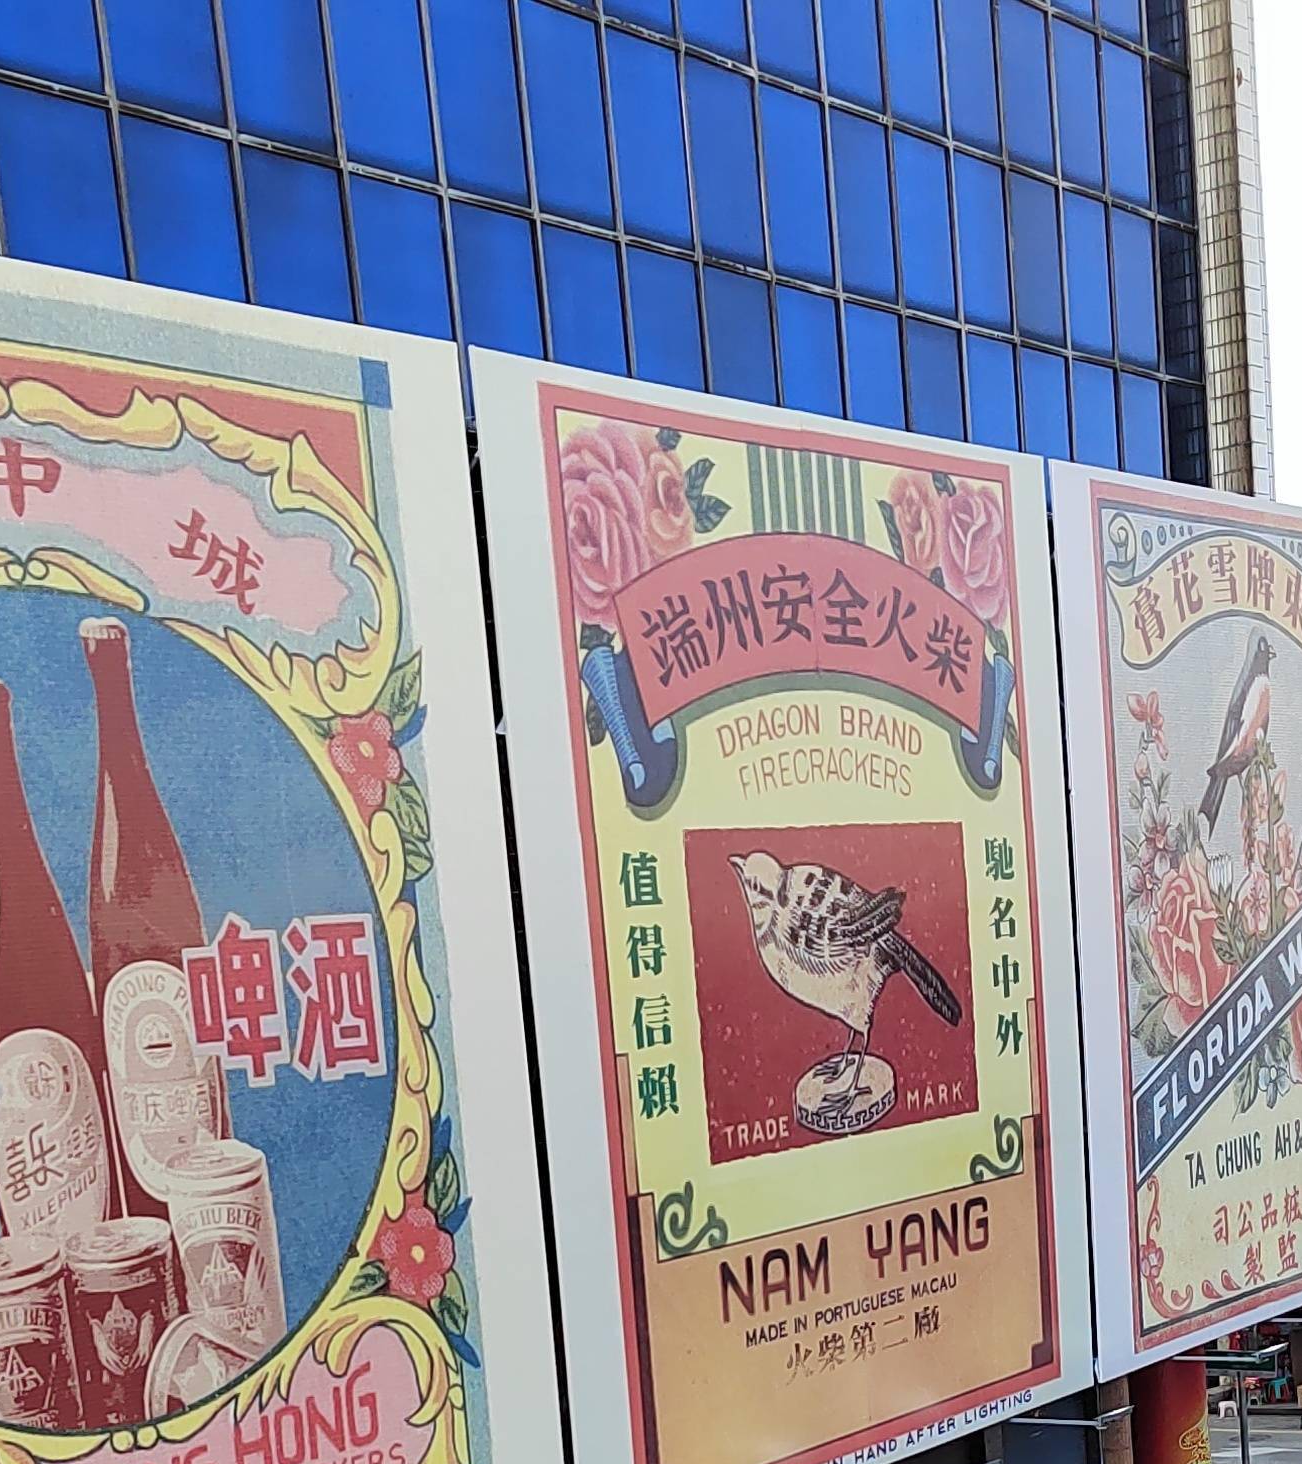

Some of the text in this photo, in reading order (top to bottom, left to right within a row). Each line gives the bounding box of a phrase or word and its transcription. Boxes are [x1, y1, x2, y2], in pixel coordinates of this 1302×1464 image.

[640, 563, 973, 694] 端州安全火柴
[716, 704, 923, 759] DRAGON BRAND
[739, 748, 912, 800] FIRECRACKERS
[619, 850, 679, 1119] 值得信賴
[984, 837, 1024, 1057] 馳名中外
[188, 920, 383, 1082] 啤酒
[1149, 974, 1273, 1143] FLORIDA
[722, 1081, 964, 1150] TRADE MARK
[1185, 1150, 1206, 1190] TA
[1215, 1130, 1262, 1181] CHUNG
[718, 1196, 990, 1324] NAM YANG
[745, 1273, 958, 1348] MADE IN PORTUGUESE MACAU
[905, 1417, 957, 1447] AFTER
[963, 1389, 1033, 1426] LIGHTING
